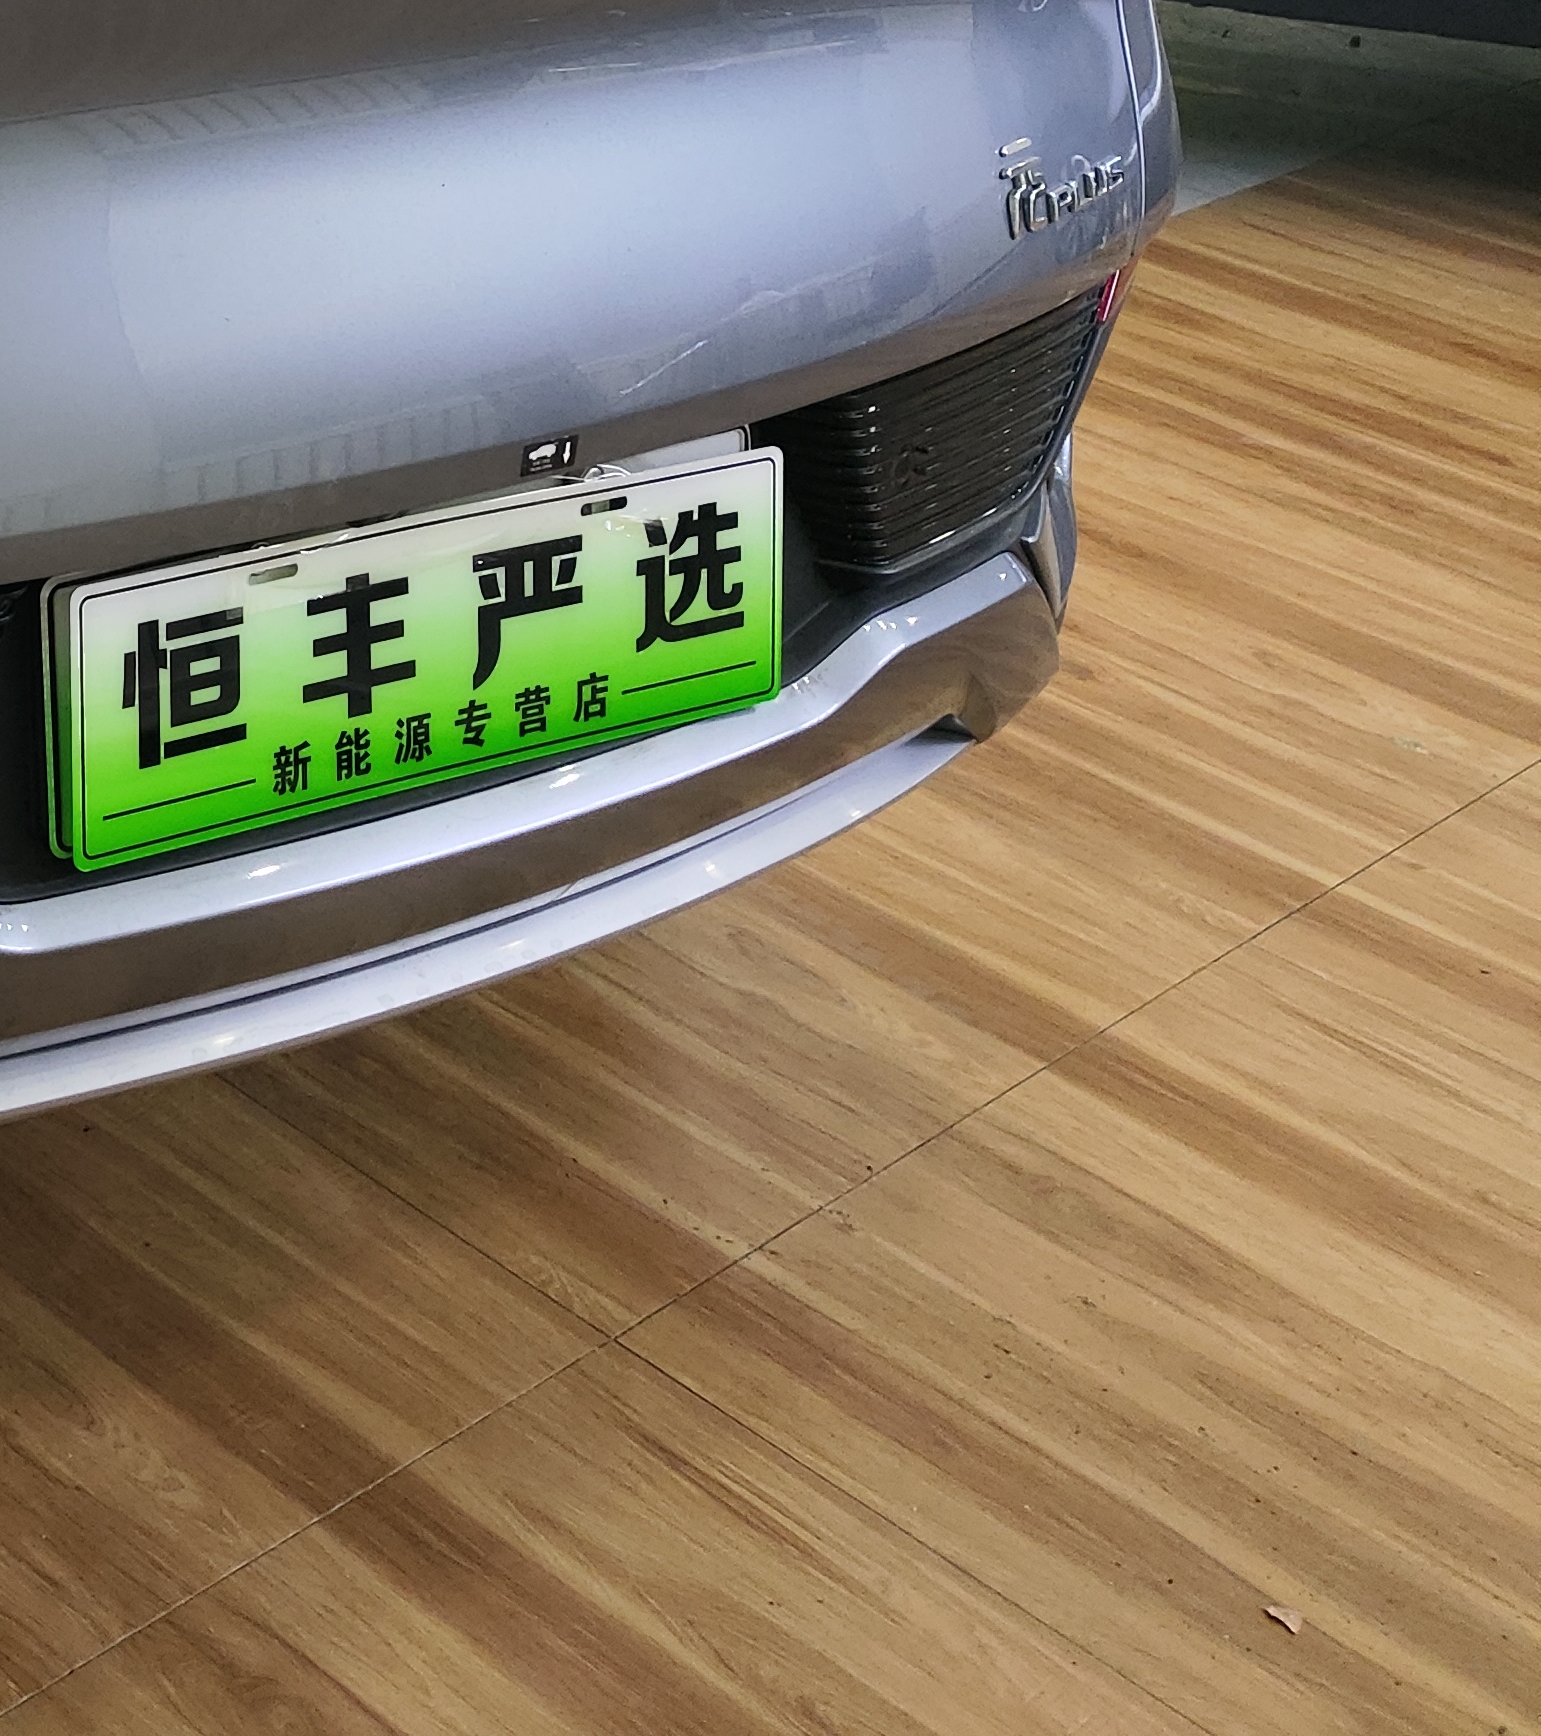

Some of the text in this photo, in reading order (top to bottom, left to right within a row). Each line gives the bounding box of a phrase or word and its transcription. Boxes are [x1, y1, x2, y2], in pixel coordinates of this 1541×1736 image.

[121, 500, 745, 771] 恒丰严选
[270, 672, 610, 796] 新能源专营店
